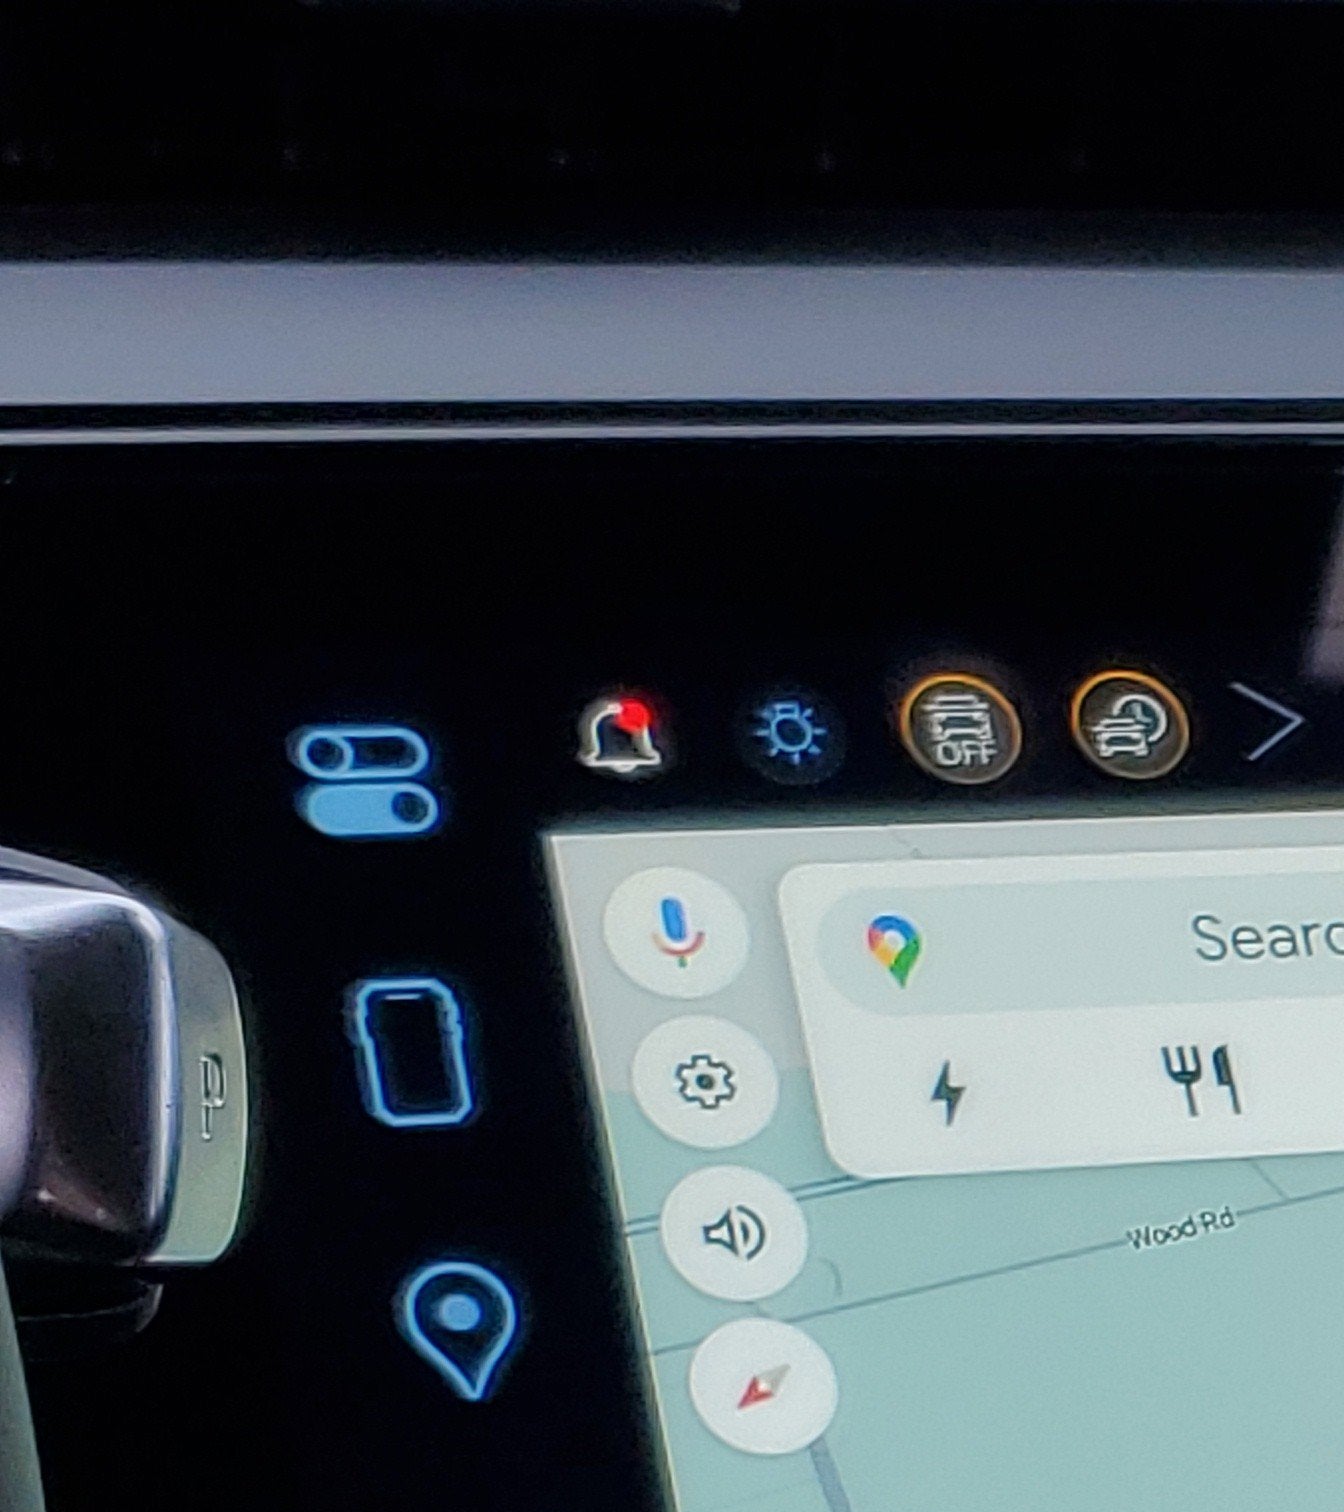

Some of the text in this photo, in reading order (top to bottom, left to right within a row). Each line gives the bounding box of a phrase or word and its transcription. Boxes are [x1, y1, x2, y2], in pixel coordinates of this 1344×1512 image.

[935, 739, 999, 766] OFF
[1125, 1204, 1236, 1250] Wood Rd
